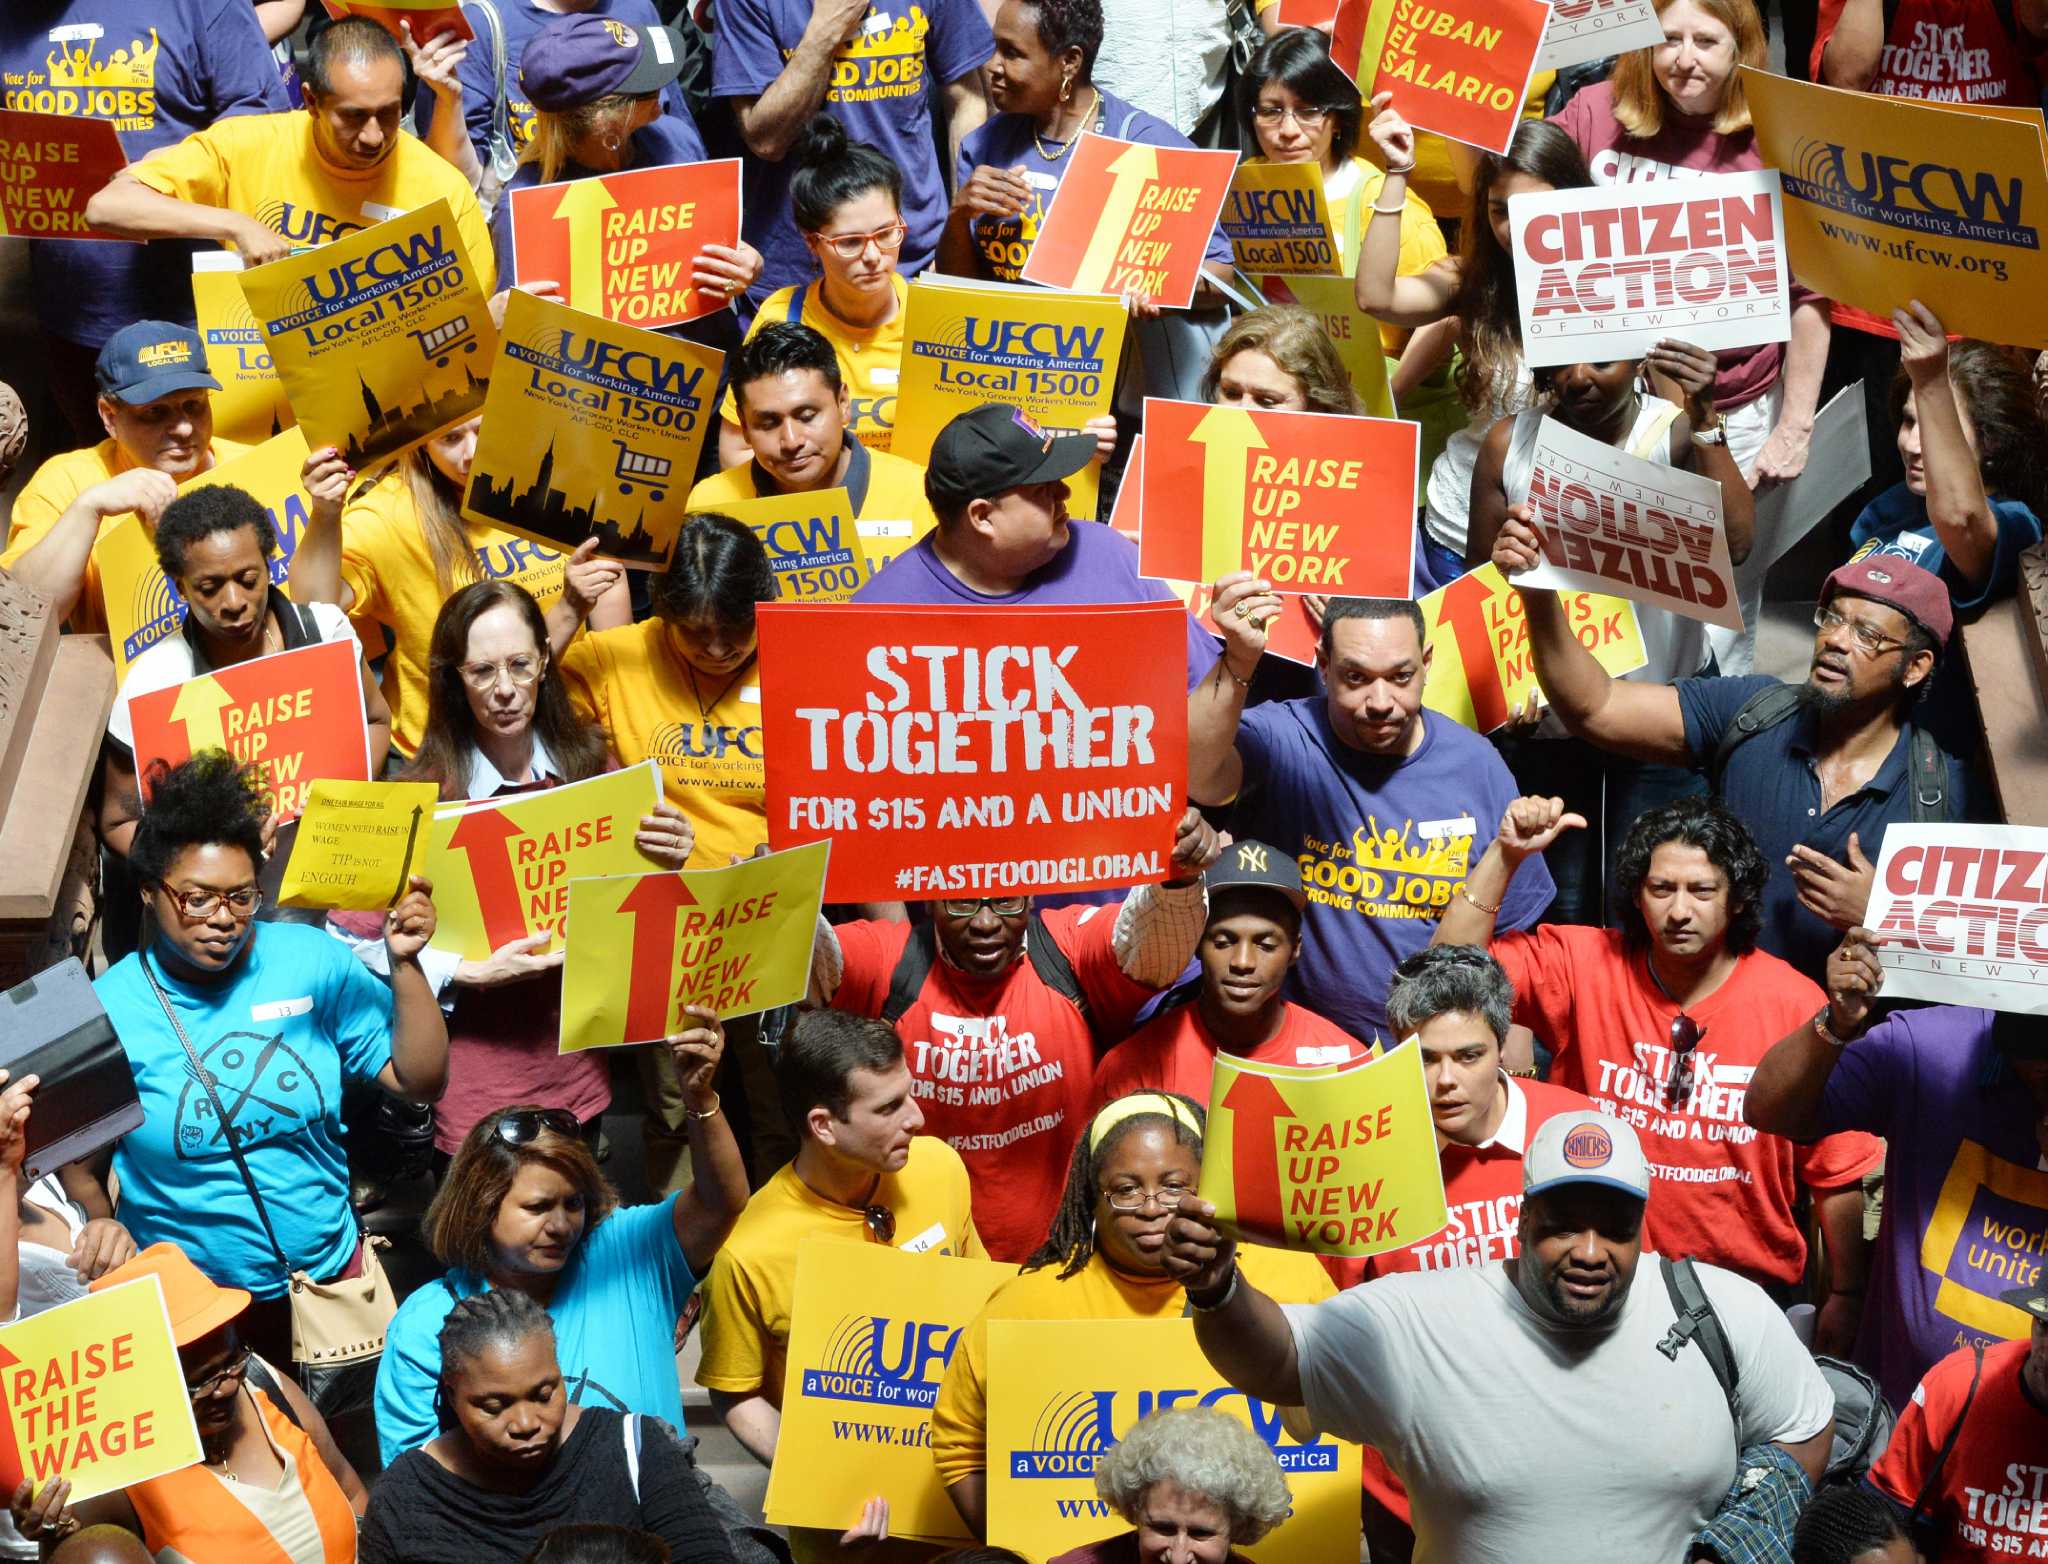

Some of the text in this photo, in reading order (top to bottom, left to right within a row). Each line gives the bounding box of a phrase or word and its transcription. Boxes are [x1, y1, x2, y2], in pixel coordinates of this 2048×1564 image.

[1395, 0, 1502, 51] SUBAN
[1570, 7, 1649, 33] YORK
[1387, 23, 1419, 56] EL
[4, 70, 46, 88] Vote for
[1381, 49, 1514, 111] SALARIO
[6, 89, 156, 116] GOOD JOBS
[0, 162, 38, 185] UP
[1826, 143, 2023, 226] UFCW
[6, 185, 75, 209] NEW
[1139, 185, 1202, 213] RAISE
[1231, 189, 1317, 225] UFCW
[1787, 179, 2034, 245] a VOICE for working America
[10, 208, 91, 232] YORK
[606, 202, 696, 236] RAISE
[995, 222, 1016, 239] for
[1130, 213, 1162, 239] UP
[1291, 226, 1325, 237] America
[1524, 193, 1774, 264] CITIZEN
[302, 224, 448, 305] UFCW
[606, 238, 649, 267] UP
[1118, 239, 1172, 268] NEW
[1237, 240, 1332, 265] Local 1500
[1820, 221, 2009, 282] www.ufcw.org
[271, 254, 454, 333] a VOICE for working America
[607, 262, 682, 295] NEW
[1110, 267, 1170, 297] YORK
[1532, 245, 1778, 316] ACTION
[302, 265, 465, 347] Local 1500
[607, 288, 692, 321] YORK
[1530, 300, 1781, 334] OF NEW YORK
[149, 340, 190, 357] UFCW
[210, 330, 261, 342] a VOICE
[309, 345, 331, 358] New
[360, 319, 398, 341] Grocery
[965, 316, 1105, 359] UFCW
[560, 328, 705, 398] UFCW
[916, 344, 1100, 371] a VOICE for working America
[509, 345, 696, 408] a VOICE for working America
[940, 362, 1101, 397] Local 1500
[531, 367, 697, 432] Local 1500
[934, 383, 956, 393] New
[986, 391, 1023, 403] Grocery
[1068, 398, 1097, 407] Union
[524, 387, 546, 402] New
[576, 405, 616, 425] Grocery
[660, 429, 691, 442] Union
[618, 428, 640, 441] CLC
[1251, 455, 1363, 490] RAISE
[1251, 488, 1301, 516] UP
[1527, 466, 1714, 564] ACTION
[876, 526, 889, 535] 14
[1249, 523, 1339, 553] NEW
[801, 552, 850, 569] America
[1249, 553, 1351, 585] YORK
[1530, 519, 1728, 610] CITIZEN
[786, 566, 860, 596] 1500
[128, 614, 183, 656] a VOICE
[866, 646, 1086, 712] STICK
[228, 688, 313, 738] RAISE
[232, 732, 268, 766] UP
[795, 706, 1156, 774] TOGETHER
[690, 758, 763, 773] for working
[789, 783, 1173, 831] FOR $15 AND A UNION
[312, 835, 340, 845] WAGE
[315, 822, 400, 835] WOMEN NEED RAISE
[517, 815, 613, 865] RAISE
[331, 853, 382, 868] TIP NOT
[1304, 833, 1354, 860] Vote for
[301, 871, 357, 885] ENGOUH
[524, 865, 567, 891] UP
[895, 851, 1165, 891] #FASTFOODGLOBAL
[1297, 853, 1384, 899] GOOD
[682, 890, 779, 939] RAISE
[680, 937, 724, 969] UP
[1931, 960, 2002, 977] NEW
[676, 953, 752, 998] NEW
[279, 1006, 292, 1017] 13
[957, 1024, 965, 1035] 8
[937, 1085, 965, 1106] $15
[1012, 1060, 1064, 1096] UNION
[1283, 1104, 1393, 1152] RAISE
[1620, 1105, 1649, 1128] $15
[1650, 1116, 1687, 1140] AND
[1690, 1122, 1703, 1141] A
[1288, 1155, 1340, 1184] UP
[1290, 1178, 1385, 1216] NEW
[1295, 1207, 1399, 1247] YORK
[914, 1240, 928, 1253] 14
[13, 1333, 134, 1407] RAISE
[807, 1375, 901, 1400] a VOICE for
[20, 1386, 97, 1444] THE
[30, 1411, 155, 1482] WAGE
[1017, 1456, 1102, 1473] a VOICE
[1991, 1532, 2023, 1555] $15
